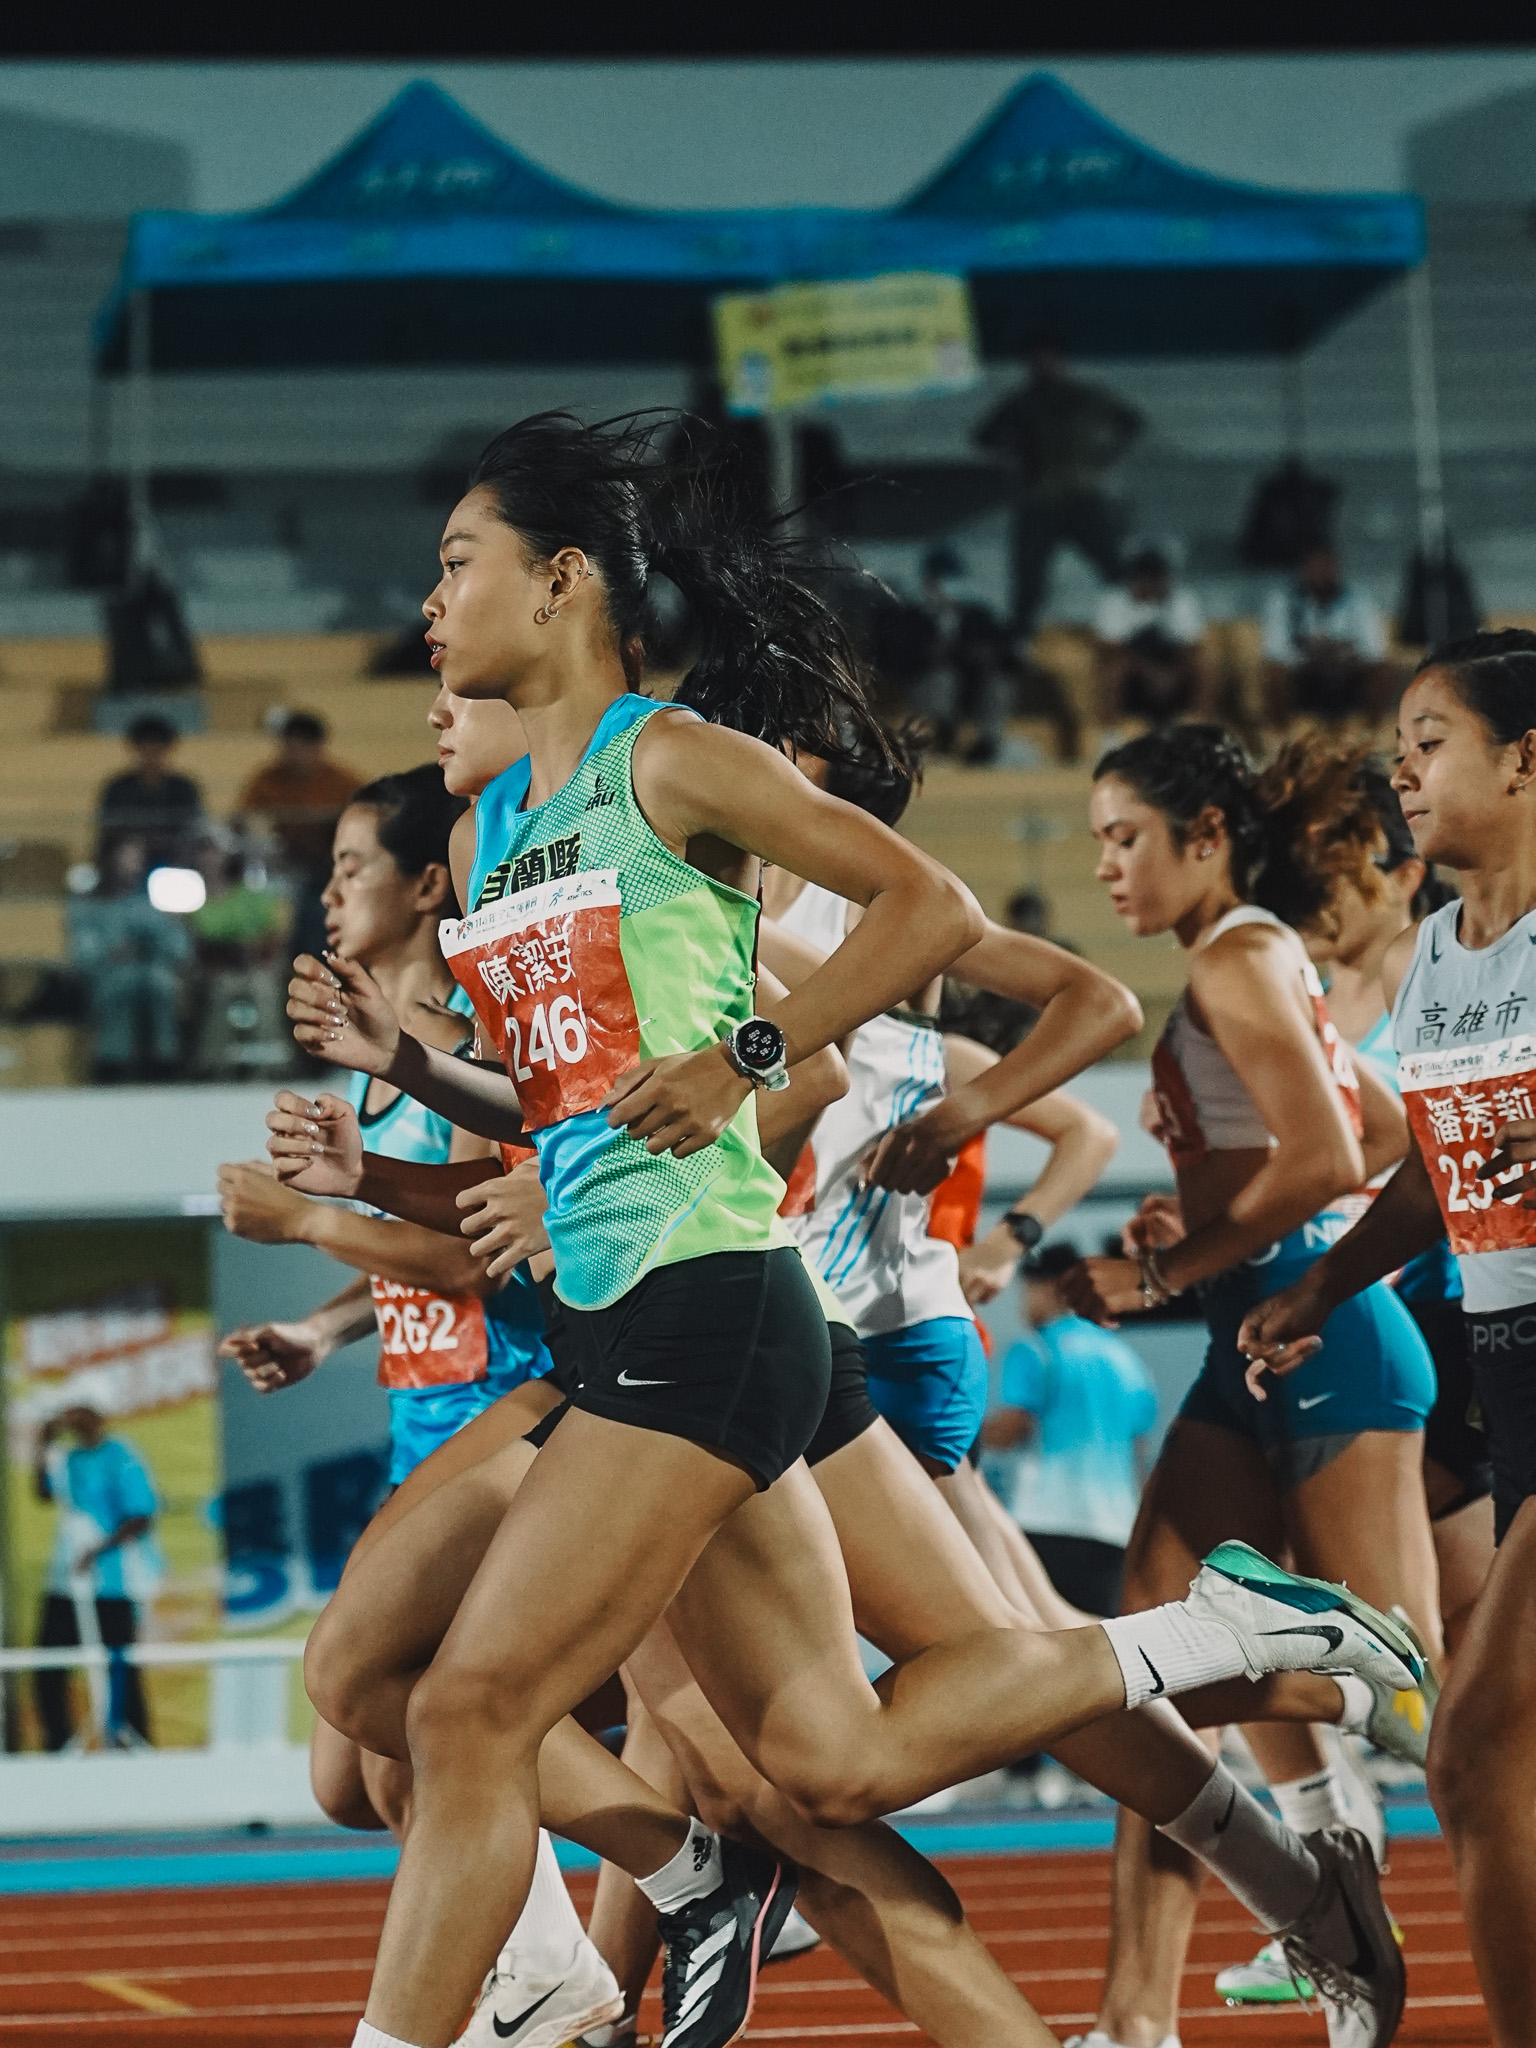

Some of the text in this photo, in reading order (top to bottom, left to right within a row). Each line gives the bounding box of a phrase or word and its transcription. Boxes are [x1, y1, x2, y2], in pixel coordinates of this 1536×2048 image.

[477, 931, 577, 1006] 陳潔安
[505, 994, 588, 1083] 246
[1415, 991, 1528, 1047] 高雄市
[382, 1300, 459, 1354] 262
